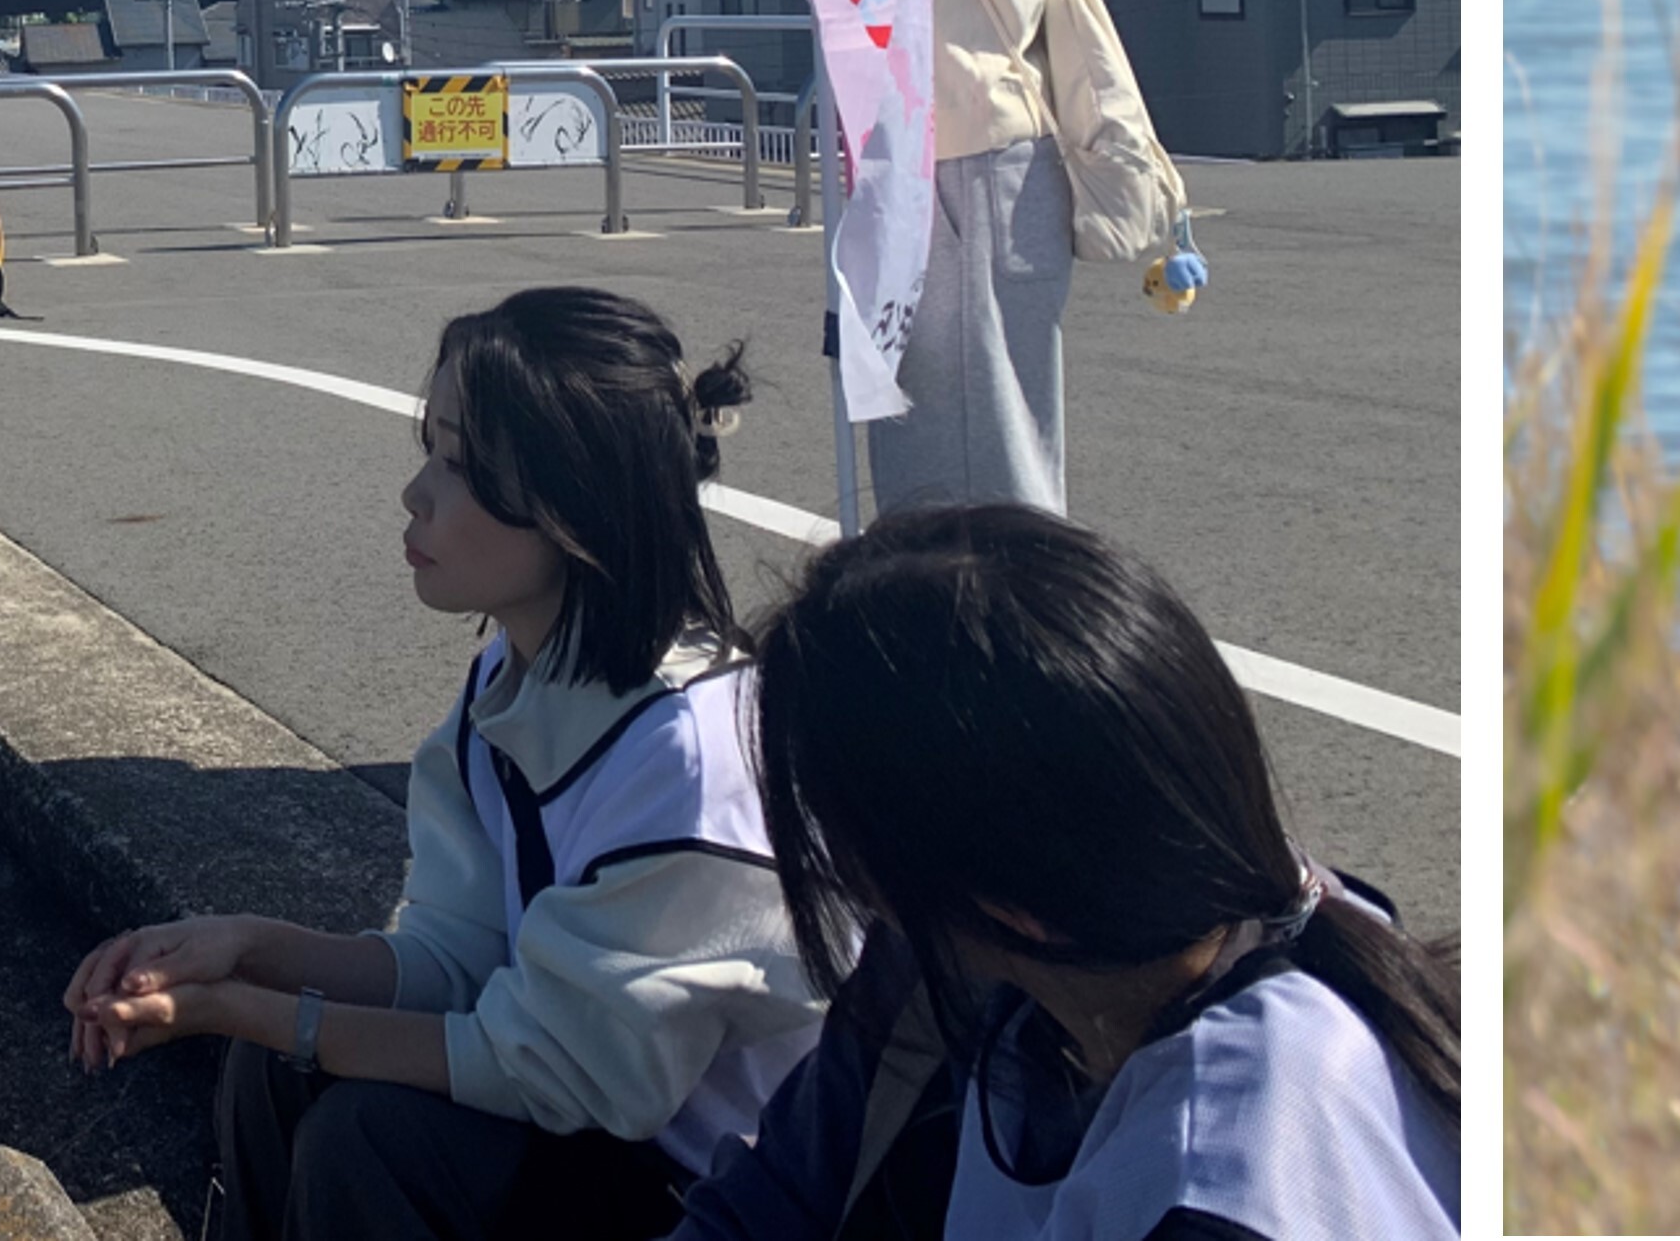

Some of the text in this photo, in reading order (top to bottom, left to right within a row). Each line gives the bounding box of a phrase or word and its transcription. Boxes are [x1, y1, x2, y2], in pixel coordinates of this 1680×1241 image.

[429, 96, 485, 117] この先
[418, 120, 496, 143] 通行不可
